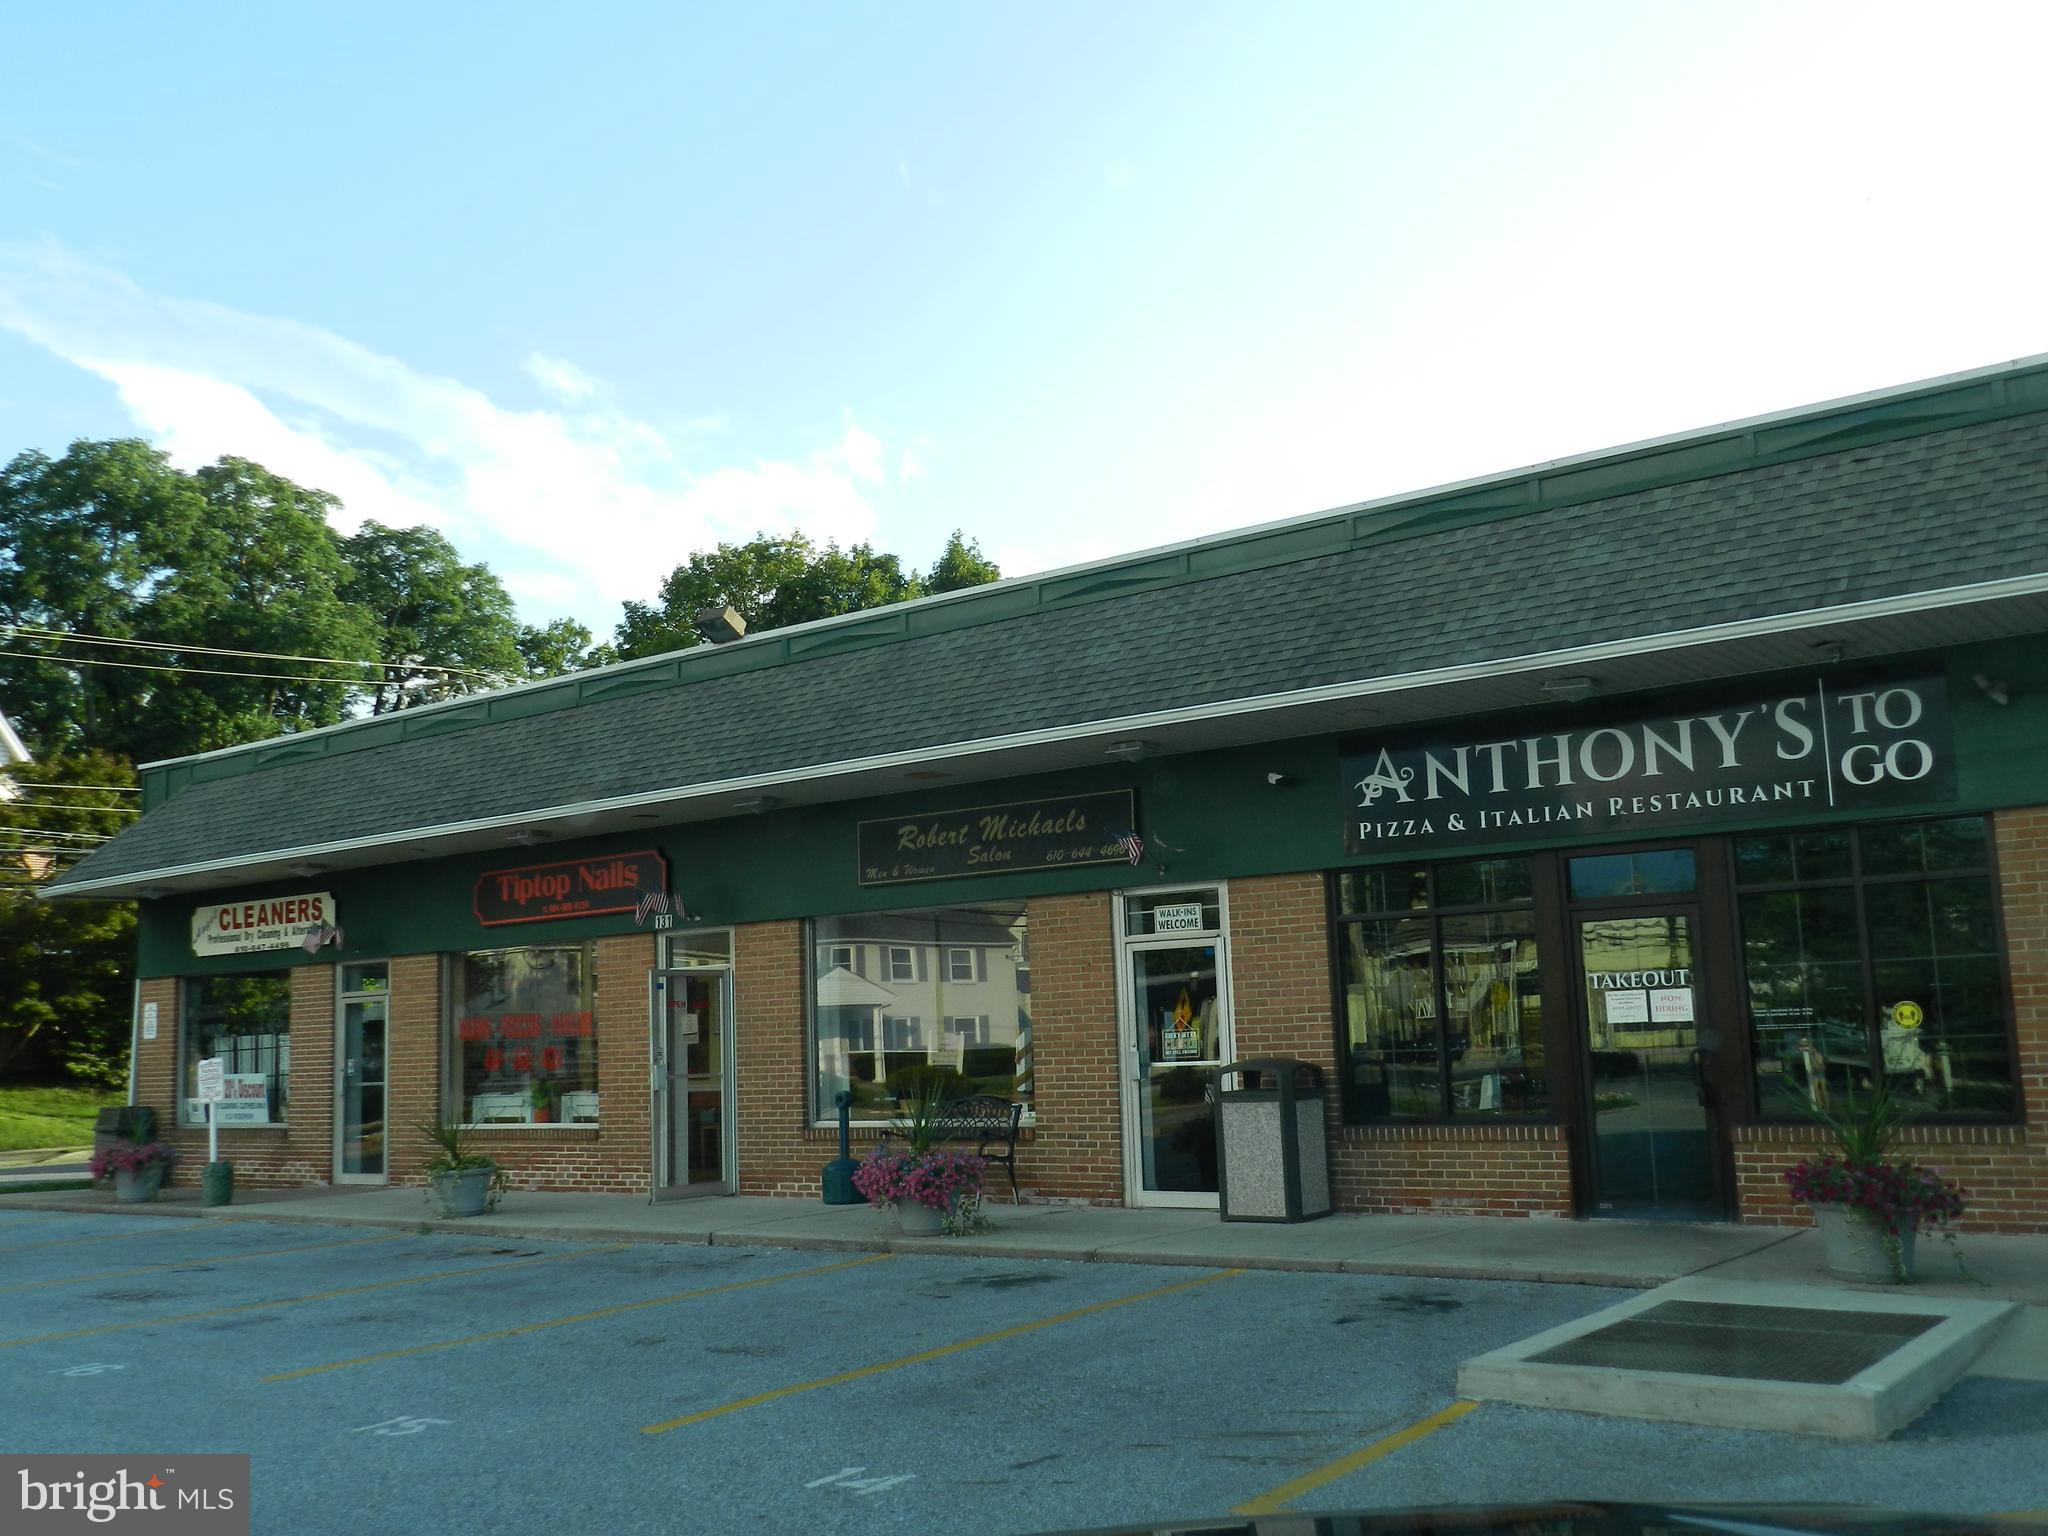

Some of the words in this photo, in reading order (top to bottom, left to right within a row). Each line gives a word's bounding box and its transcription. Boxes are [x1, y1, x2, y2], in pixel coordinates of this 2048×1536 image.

[1838, 688, 1923, 735] TO
[1354, 697, 1814, 808] ANTHONY'S
[1841, 739, 1933, 786] GO
[1358, 817, 1435, 840] PIZZA
[1447, 813, 1466, 833] &
[1479, 801, 1593, 829] ITALIAN
[1607, 779, 1815, 818] RESTAURANT
[898, 824, 969, 852] Robert
[979, 808, 1088, 842] Michaels
[865, 868, 888, 879] Men
[904, 863, 935, 876] Women
[967, 845, 1012, 865] Salon
[497, 872, 571, 905] Tiptop
[578, 861, 640, 893] Nails
[219, 897, 323, 931] CLEANERS
[656, 915, 672, 928] 131
[1158, 918, 1199, 930] WELCOME
[208, 931, 241, 943] Professional
[245, 930, 254, 943] Dry
[257, 928, 281, 941] Cleaning
[1588, 969, 1689, 990] TAKEOUT
